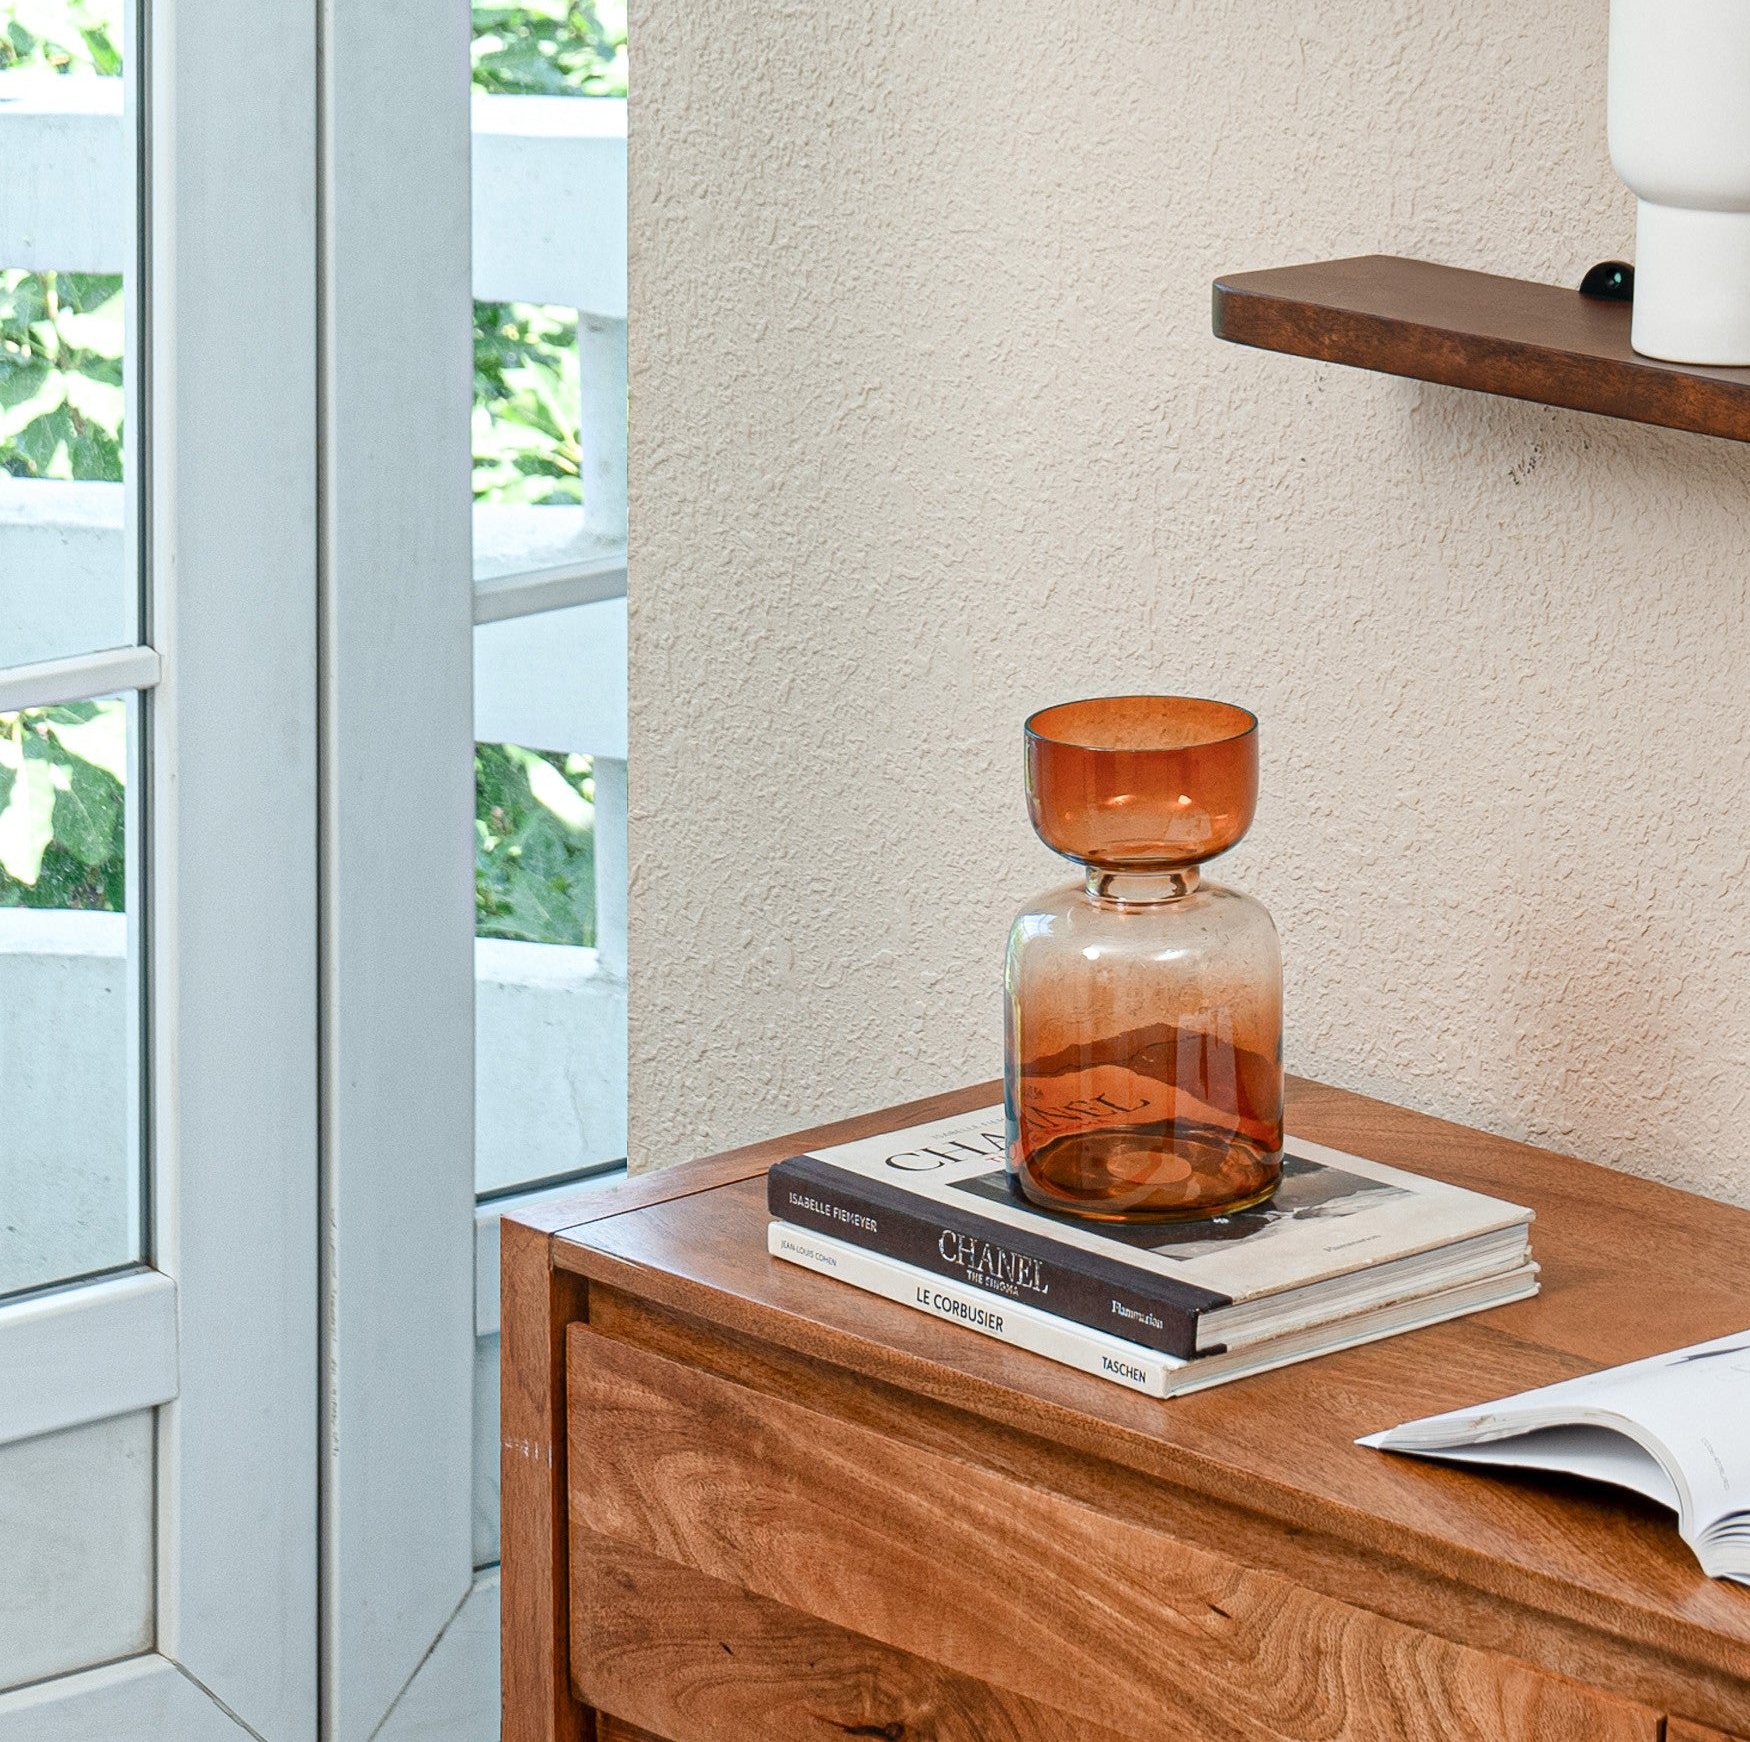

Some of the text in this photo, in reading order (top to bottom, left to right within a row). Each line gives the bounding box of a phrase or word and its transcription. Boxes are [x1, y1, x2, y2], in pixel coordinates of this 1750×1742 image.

[789, 1191, 879, 1234] ISABELLE FIEMEYER
[938, 1229, 1050, 1295] CHANEL
[966, 1269, 984, 1285] THE
[916, 1286, 1004, 1333] LE CORBUSIER
[1102, 1356, 1147, 1384] TASCHEN
